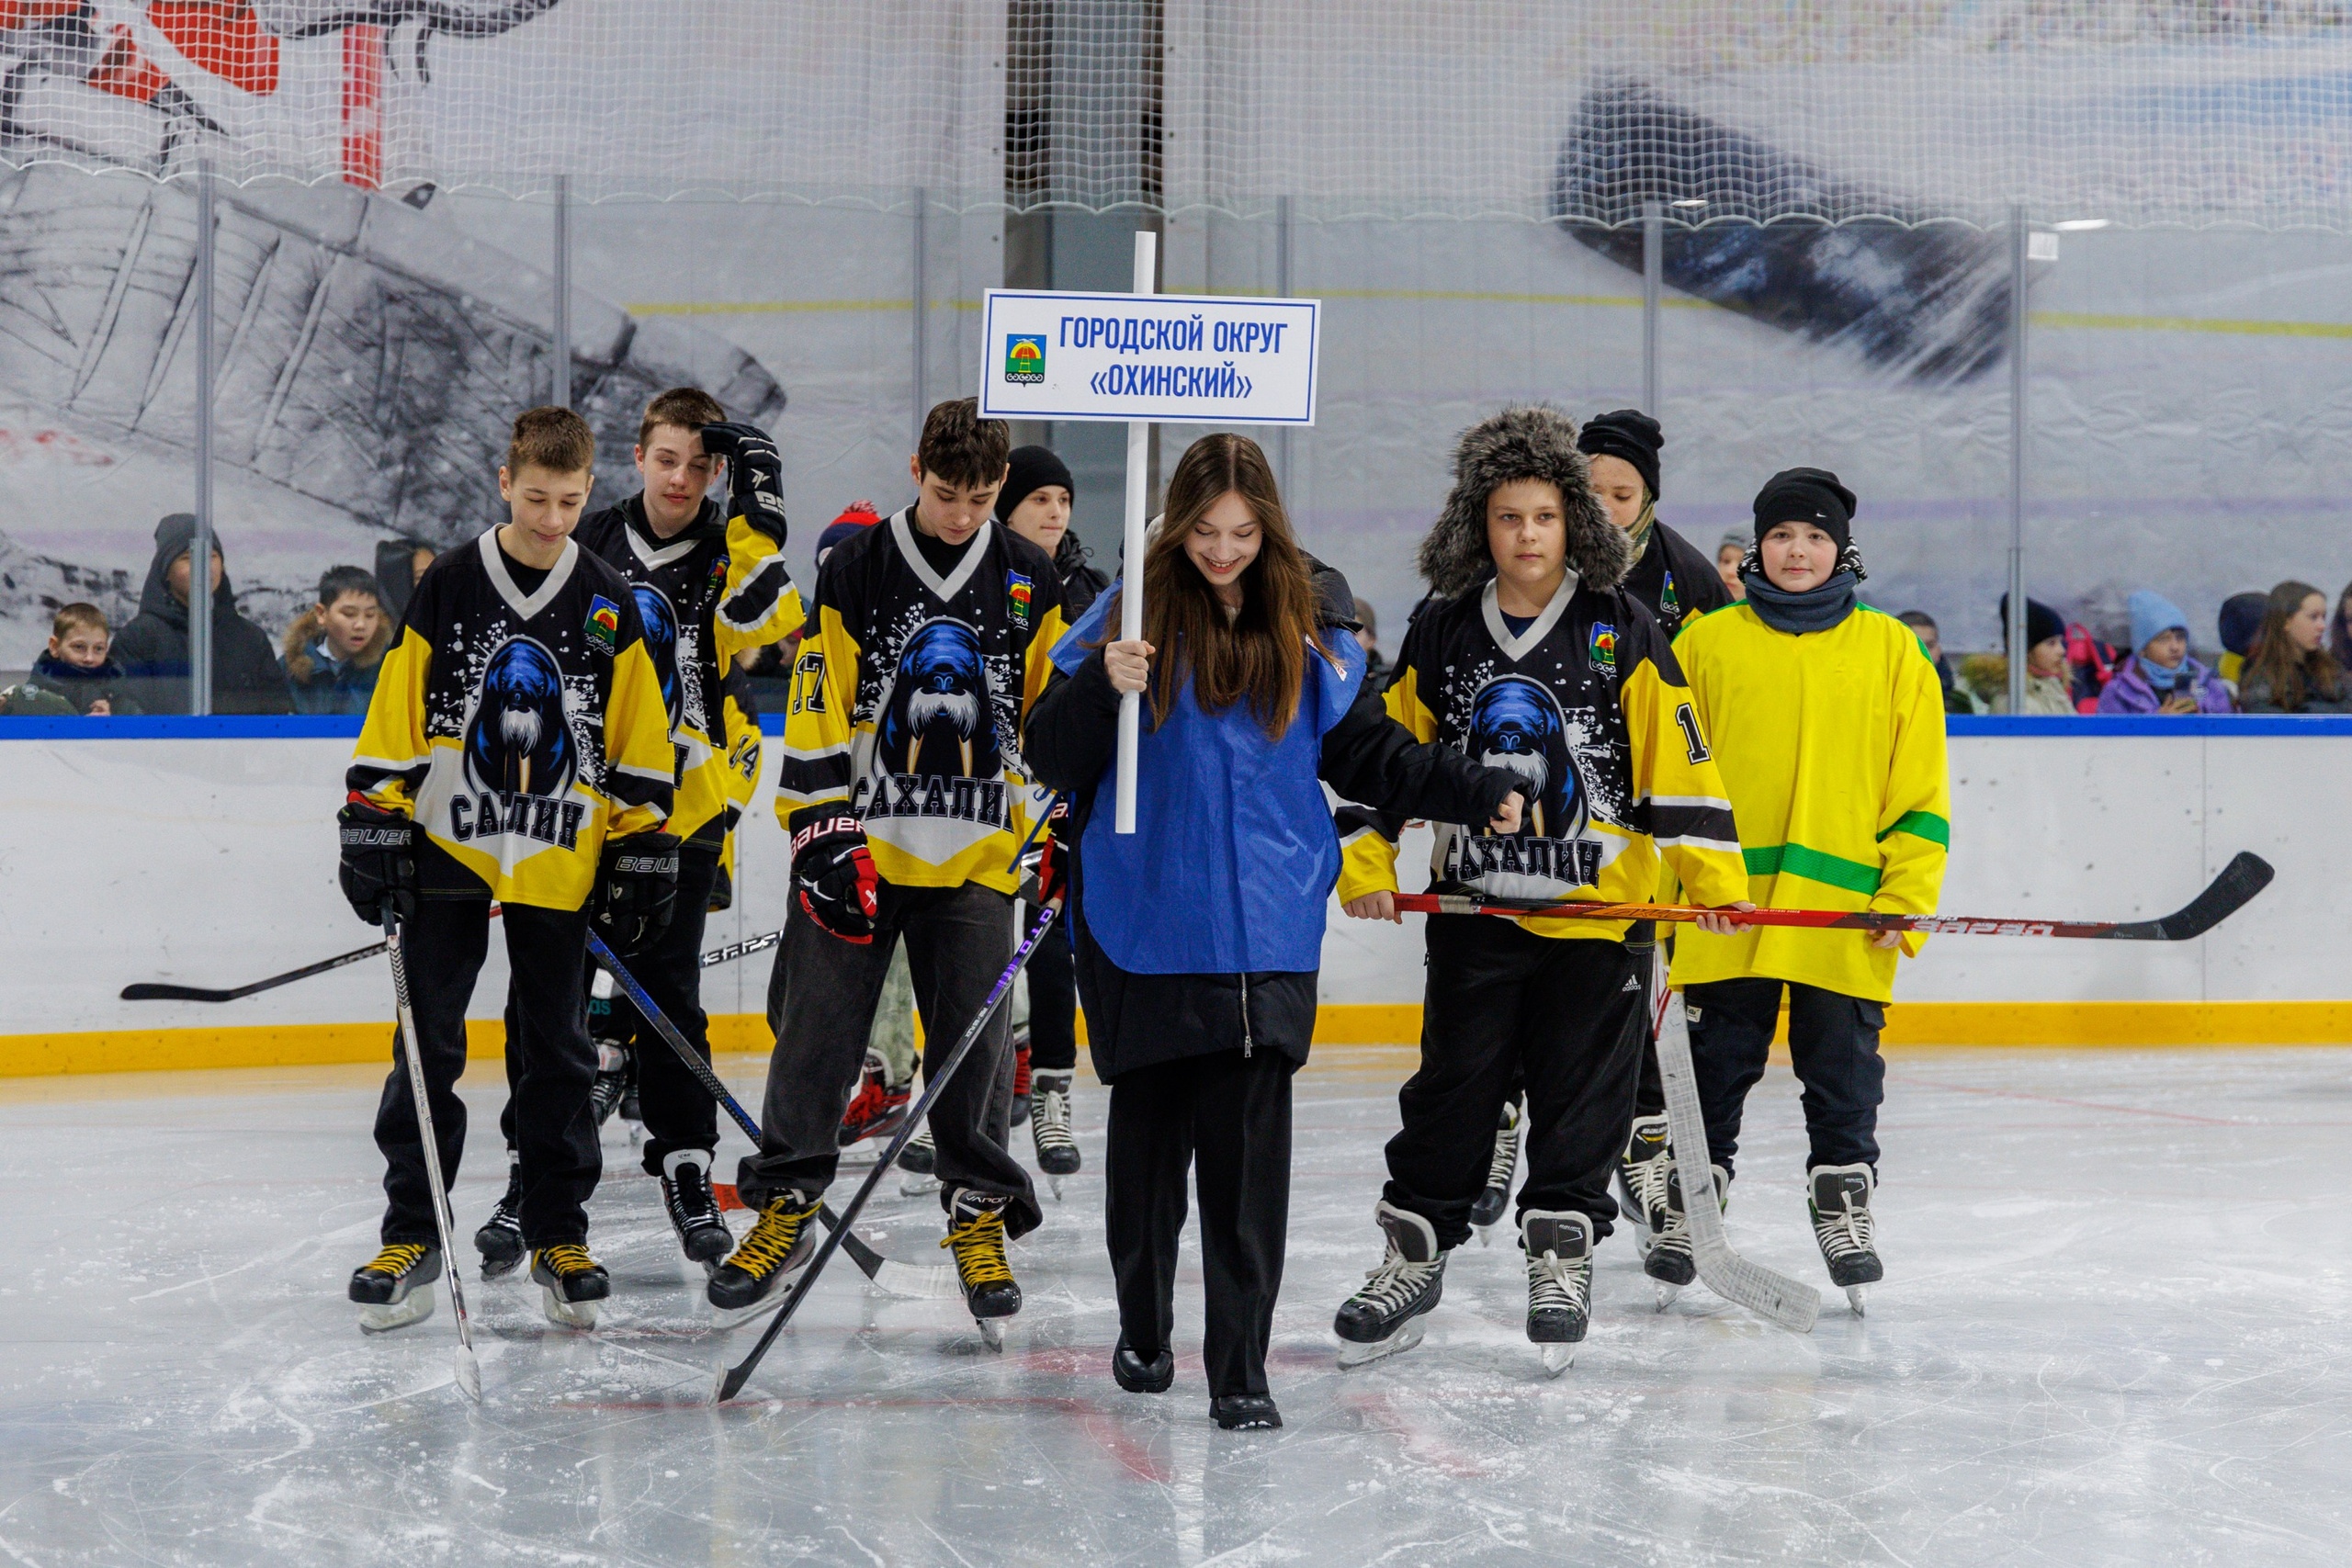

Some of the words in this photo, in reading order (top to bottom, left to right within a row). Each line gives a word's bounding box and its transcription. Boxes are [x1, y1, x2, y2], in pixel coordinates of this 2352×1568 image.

[1059, 313, 1203, 355] ГОРОДСКОЙ
[1213, 321, 1288, 354] ОКРУГ
[1090, 361, 1252, 399] «ОХИНСКИЙ»
[792, 651, 826, 715] 17
[1675, 702, 1712, 766] 1
[449, 790, 585, 852] САЛИН
[615, 855, 679, 873] BAU
[1442, 834, 1603, 889] САХАЛИН
